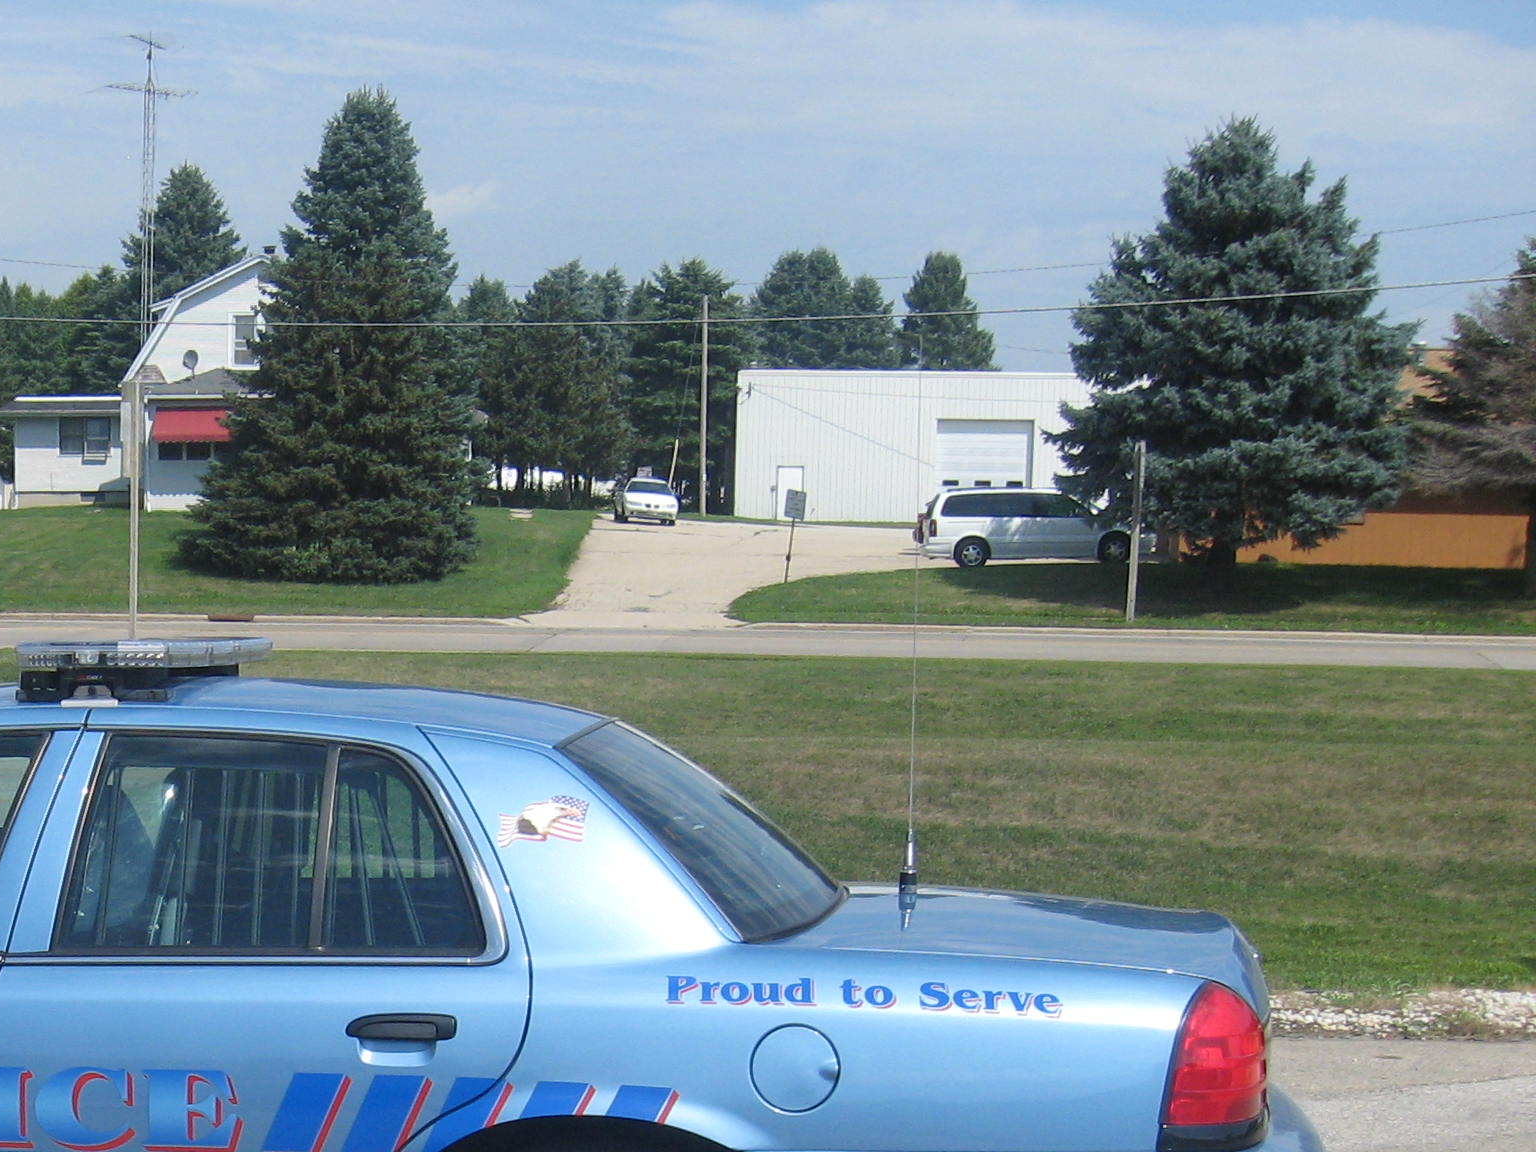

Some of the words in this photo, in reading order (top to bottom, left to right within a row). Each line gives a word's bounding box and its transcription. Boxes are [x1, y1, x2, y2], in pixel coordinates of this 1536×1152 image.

[666, 975, 817, 1007] Proud
[840, 979, 896, 1009] to
[919, 981, 1063, 1018] Serve
